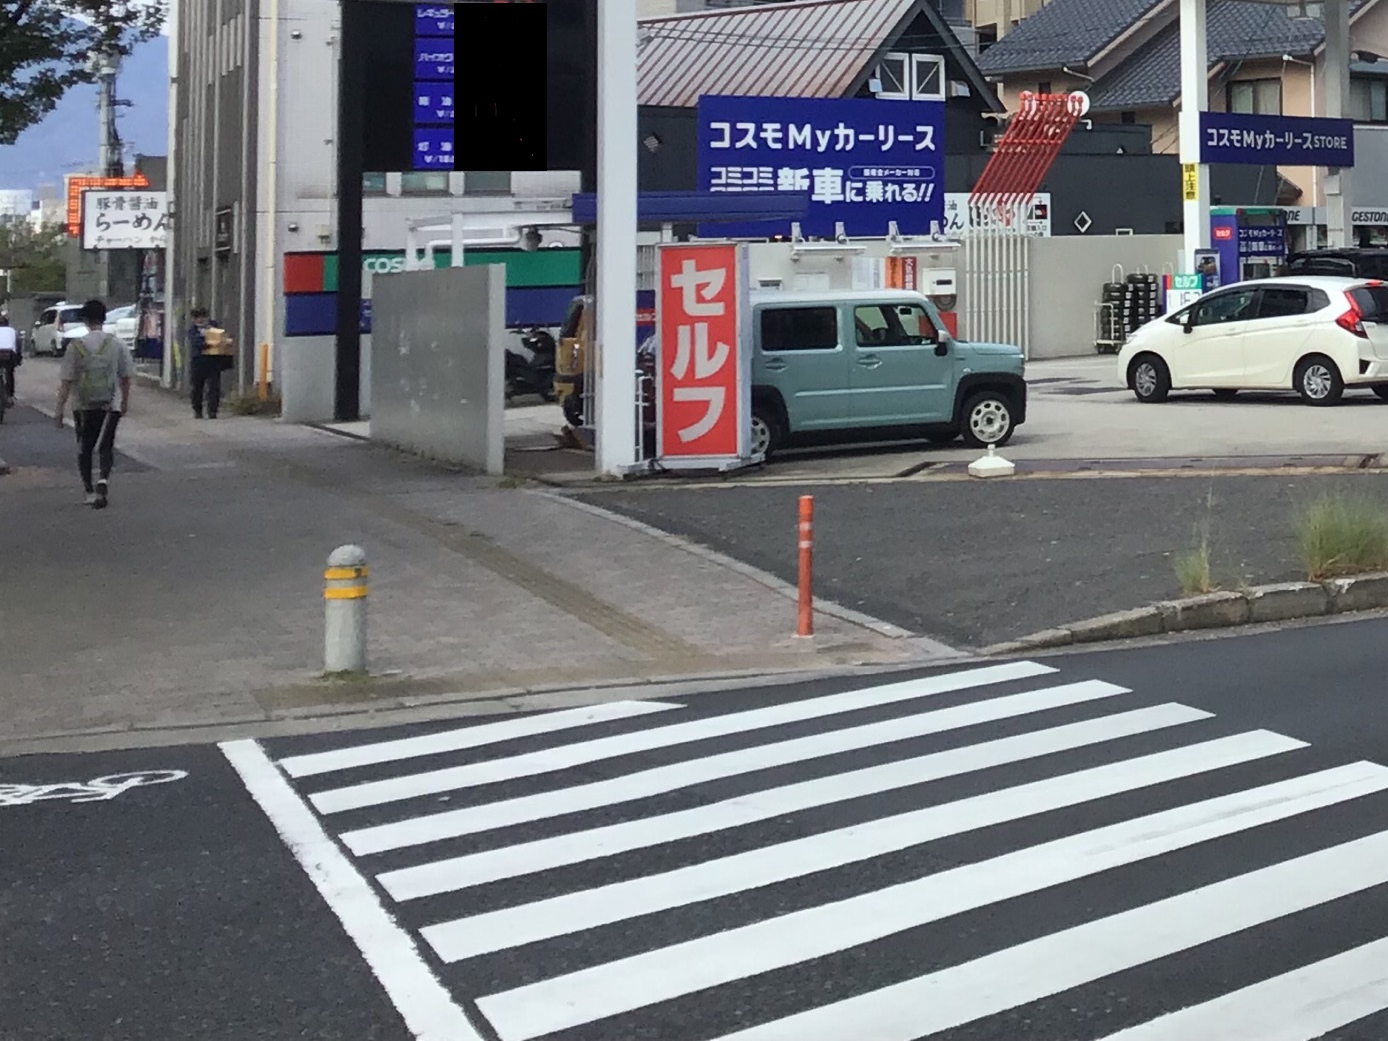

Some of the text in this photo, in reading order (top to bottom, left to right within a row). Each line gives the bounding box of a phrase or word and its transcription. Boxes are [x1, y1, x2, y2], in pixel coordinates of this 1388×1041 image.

[710, 122, 936, 152] コスモMyカーリース
[670, 259, 731, 443] セルフ
